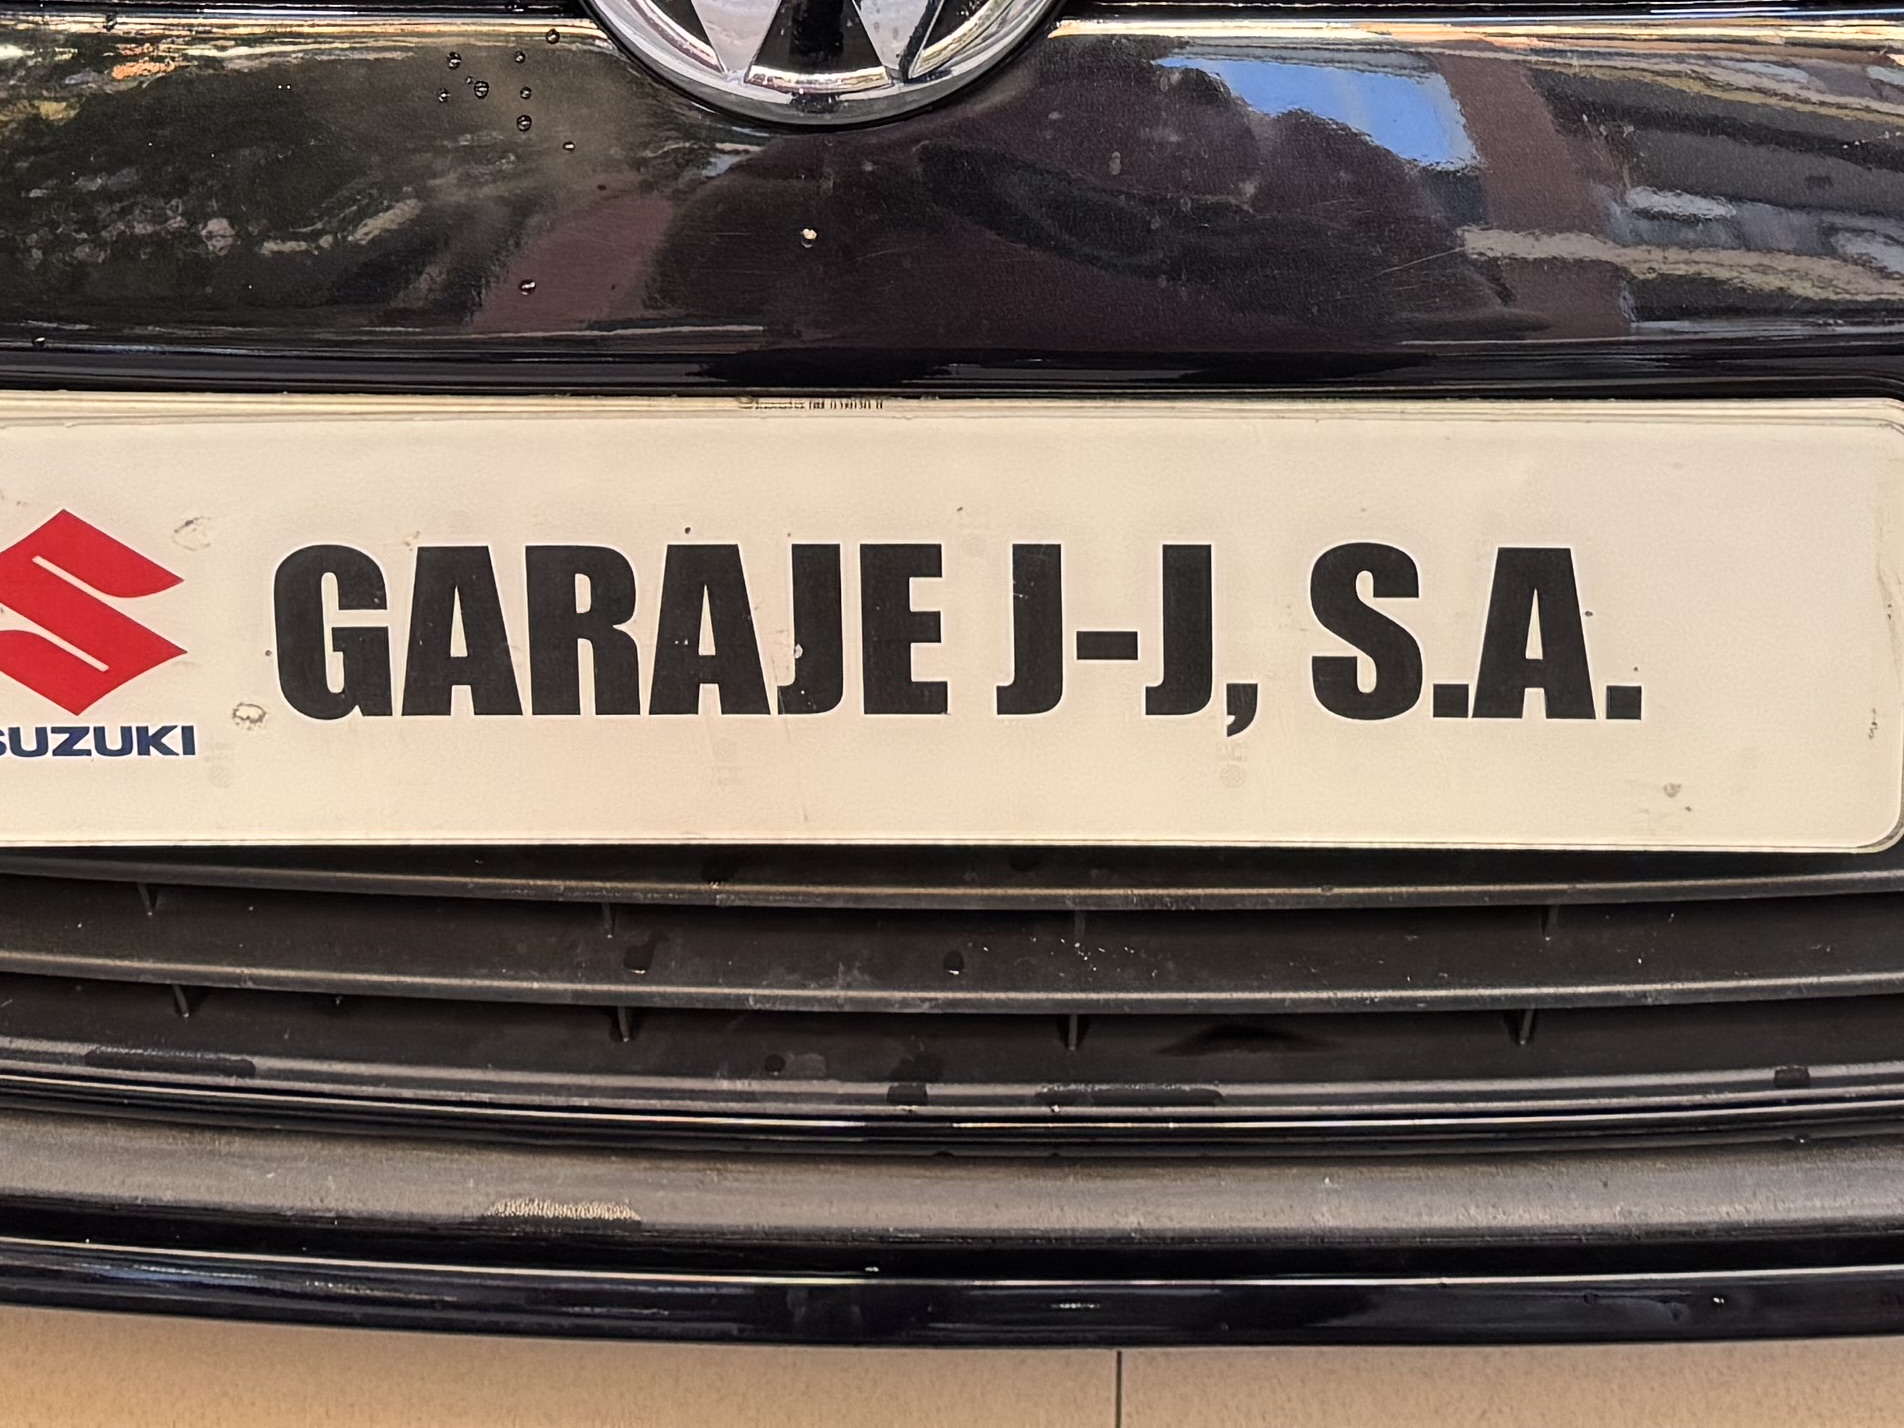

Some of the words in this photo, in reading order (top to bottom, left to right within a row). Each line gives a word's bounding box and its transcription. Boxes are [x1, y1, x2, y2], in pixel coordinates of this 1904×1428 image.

[274, 543, 947, 721] GARAJE
[997, 543, 1257, 737] J-J,
[1311, 542, 1642, 721] S.A.
